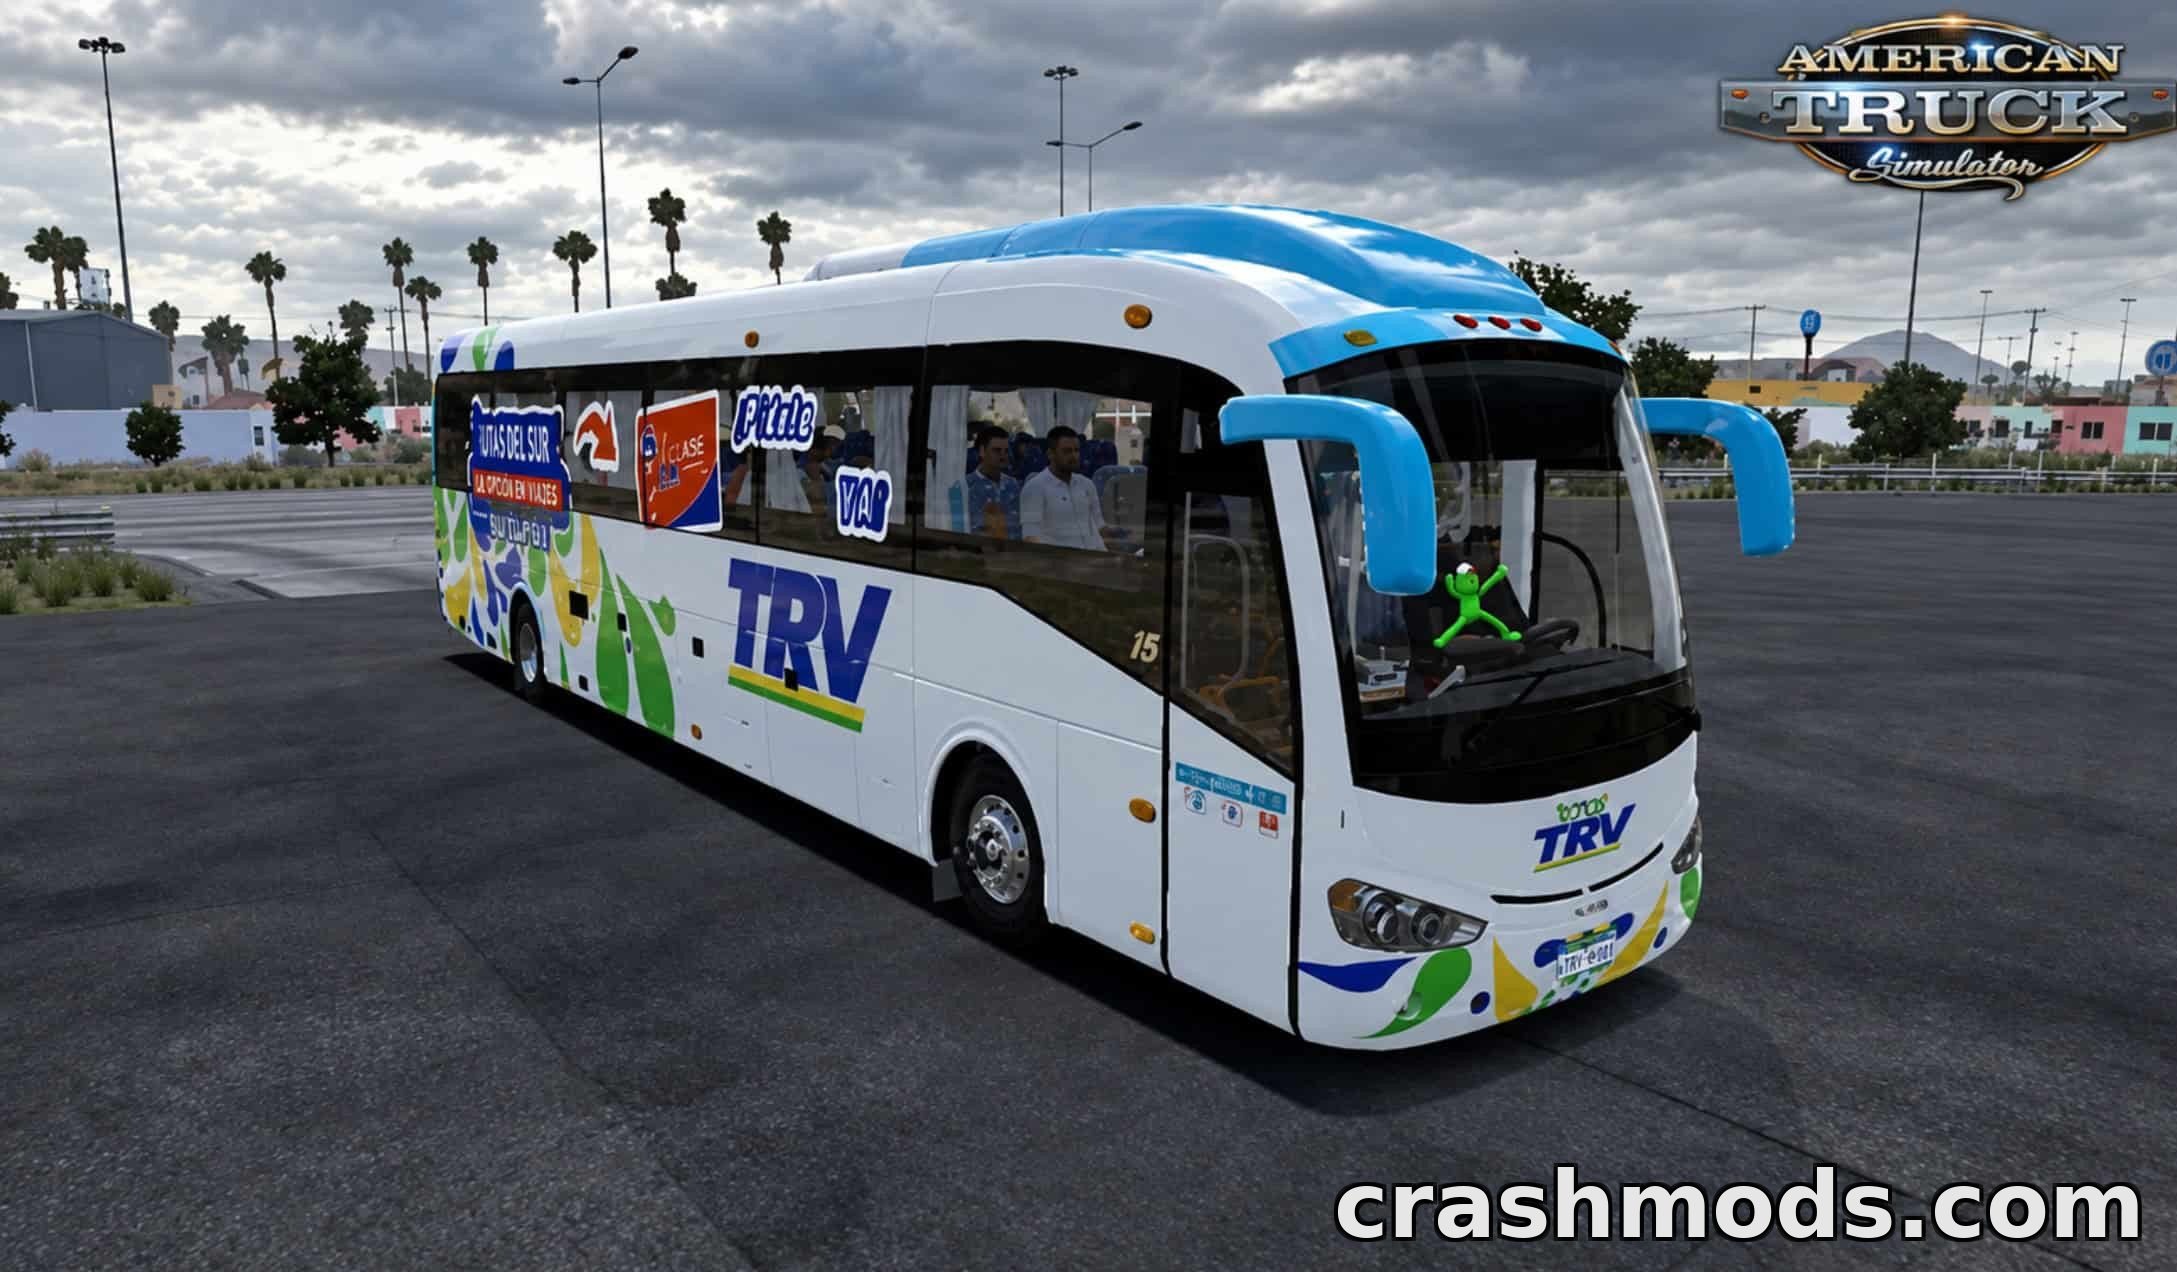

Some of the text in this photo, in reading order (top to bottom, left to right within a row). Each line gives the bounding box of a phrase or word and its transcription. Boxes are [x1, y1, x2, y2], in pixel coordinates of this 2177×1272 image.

[507, 424, 527, 462] DEL
[527, 425, 551, 464] SUR
[728, 558, 892, 704] TRV
[1129, 630, 1161, 663] 15
[1534, 803, 1637, 865] TRV
